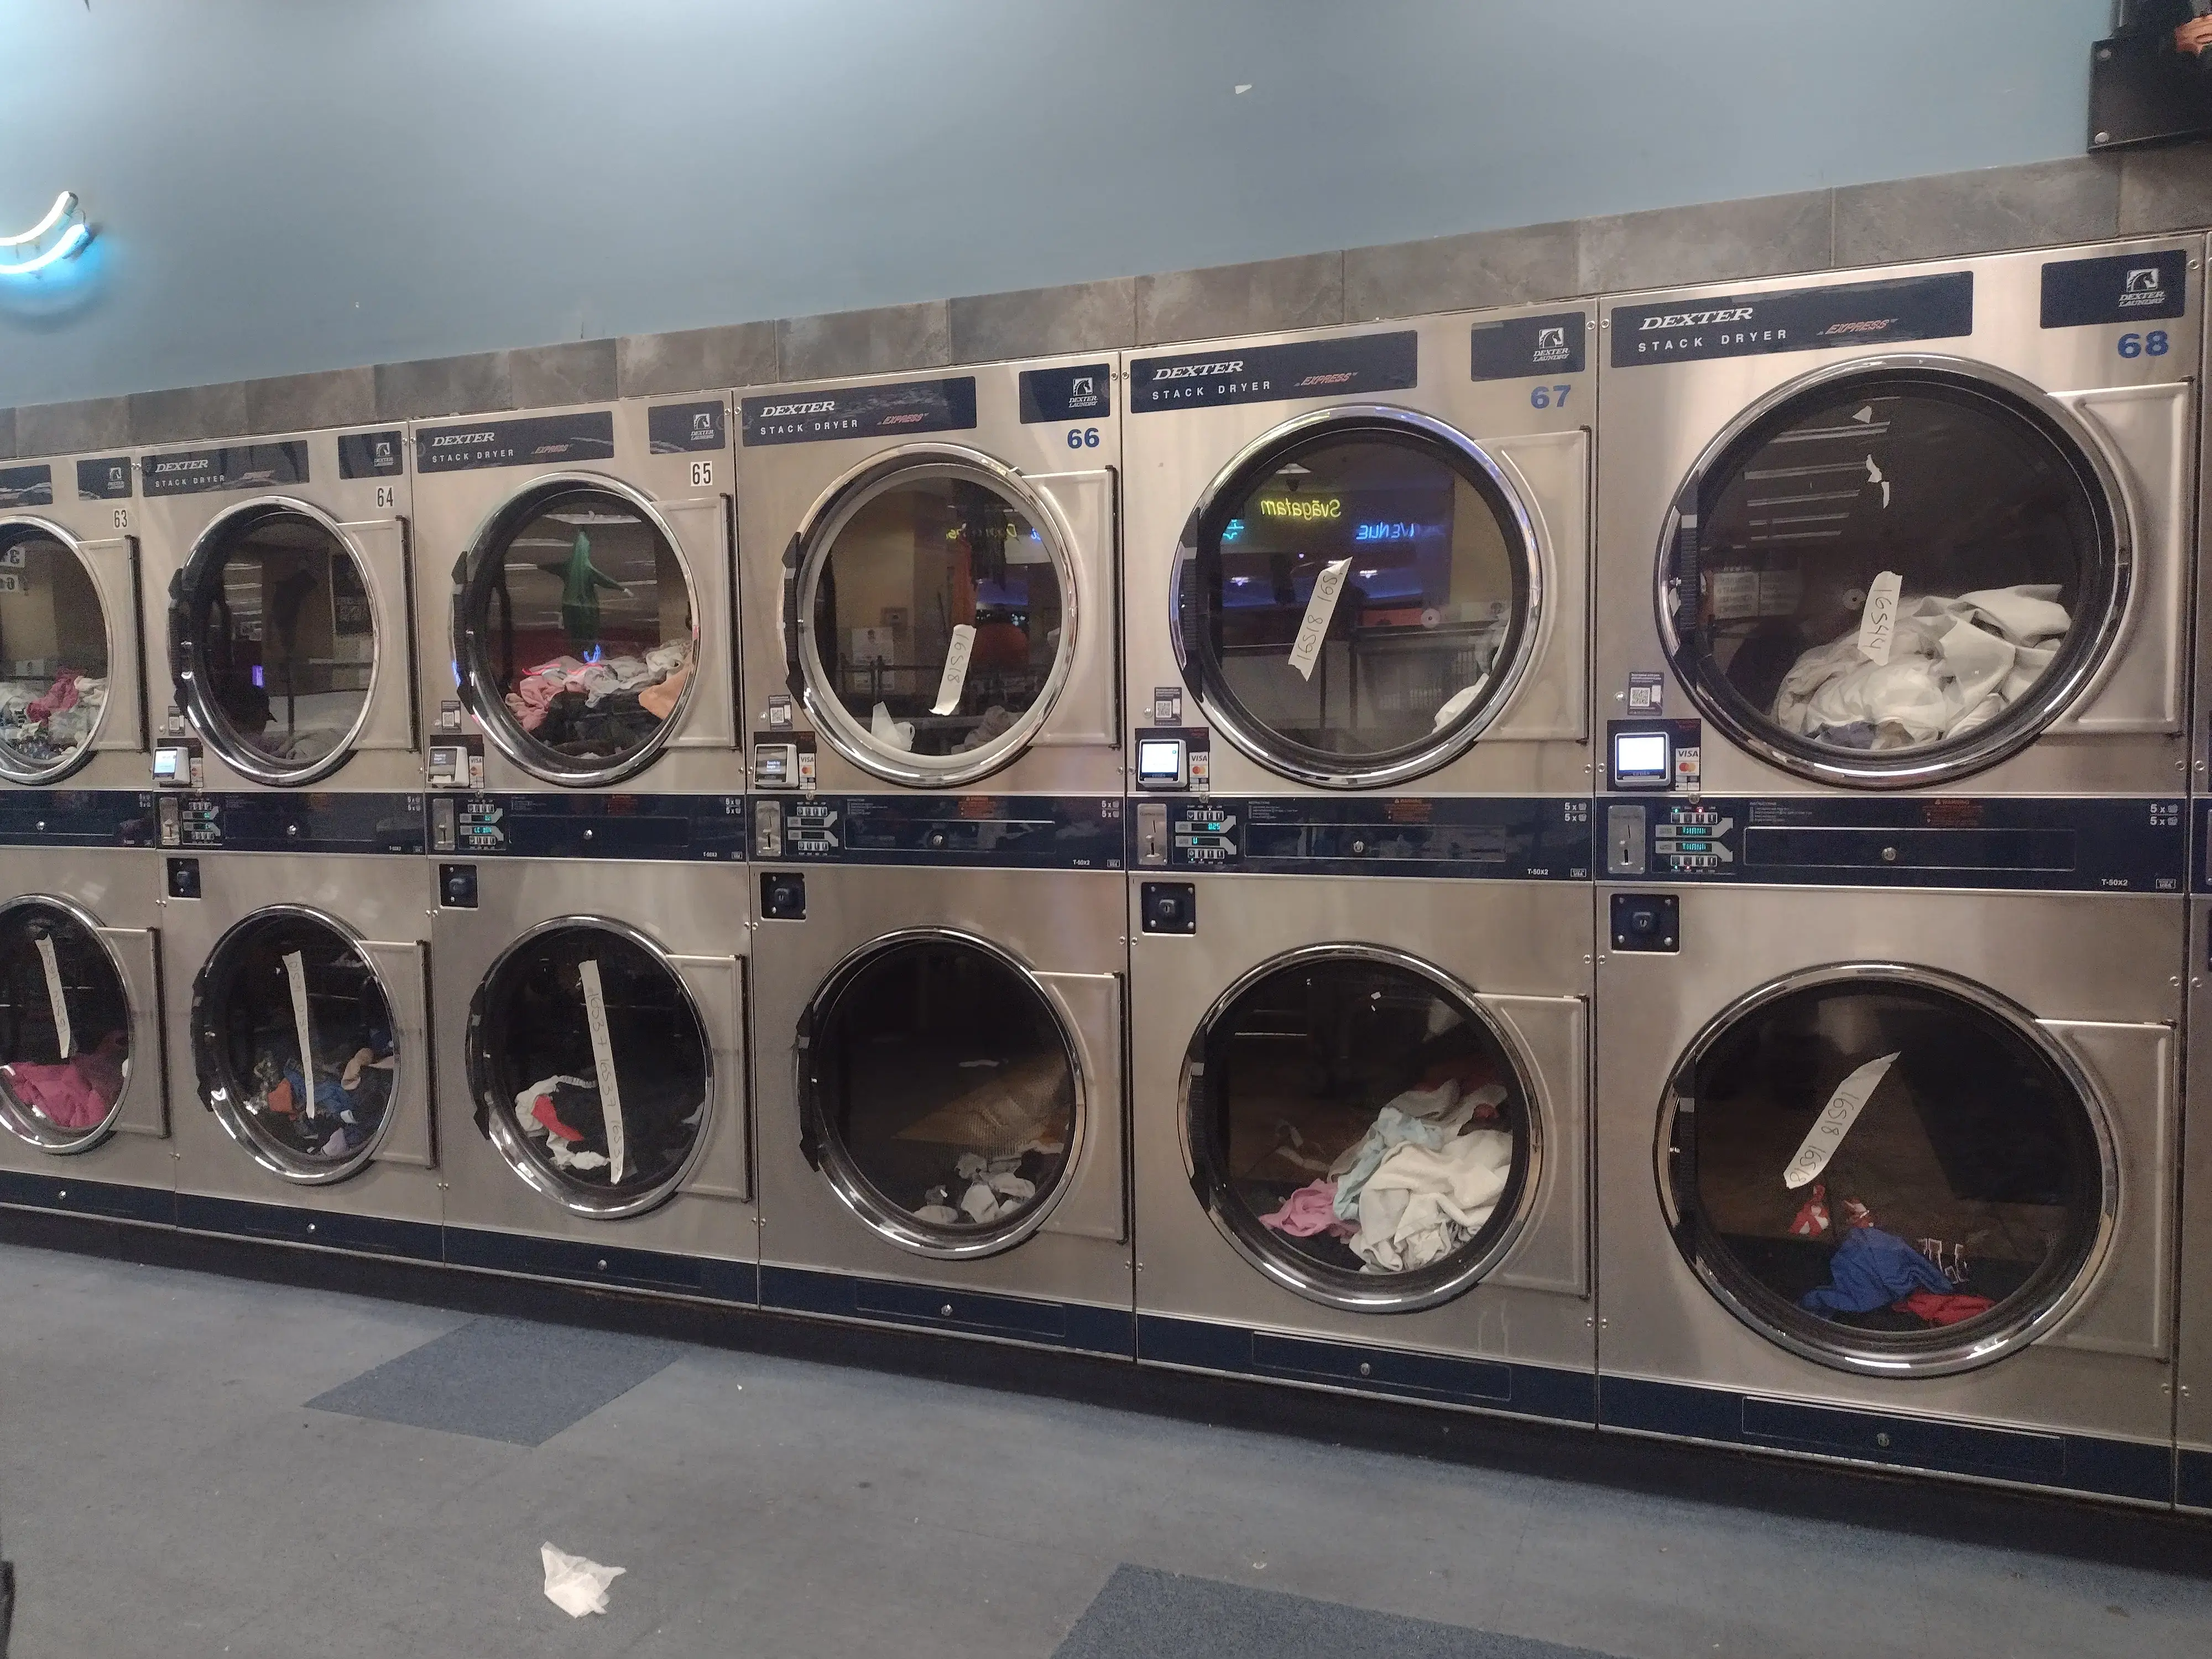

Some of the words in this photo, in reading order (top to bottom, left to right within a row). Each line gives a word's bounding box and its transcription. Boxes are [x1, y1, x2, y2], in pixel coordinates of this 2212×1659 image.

[2120, 290, 2165, 301] DEXTER
[1640, 307, 1753, 331] DEXTER
[1825, 319, 1889, 335] EXPRESS
[1639, 336, 1704, 353] STACK
[1720, 329, 1787, 346] DRYER
[2117, 330, 2169, 358] 68
[1533, 347, 1569, 357] DEXTER
[1152, 361, 1244, 381] DEXTER
[1300, 372, 1353, 387] EXPRESS
[1152, 386, 1204, 401] STACK
[1218, 380, 1271, 394] DRYER
[1530, 384, 1571, 409] 67
[760, 400, 835, 418] DEXTER
[760, 423, 804, 436] STACK
[815, 419, 858, 431] DRYER
[881, 413, 924, 425] EXPRESS
[432, 431, 494, 447] DEXTER
[1067, 427, 1100, 449] 66
[432, 451, 469, 463] STACK
[477, 448, 514, 460] DRYER
[155, 459, 208, 473] DEXTER
[692, 462, 711, 485] 65
[155, 478, 186, 488] STACK
[193, 474, 226, 486] DRYER
[377, 487, 393, 507] 64
[113, 509, 128, 529] 63
[1861, 589, 1893, 649] 16544
[947, 633, 969, 684] 16518
[2150, 804, 2158, 813] 5
[2150, 816, 2158, 826] 5
[1821, 1092, 1860, 1136] 16518
